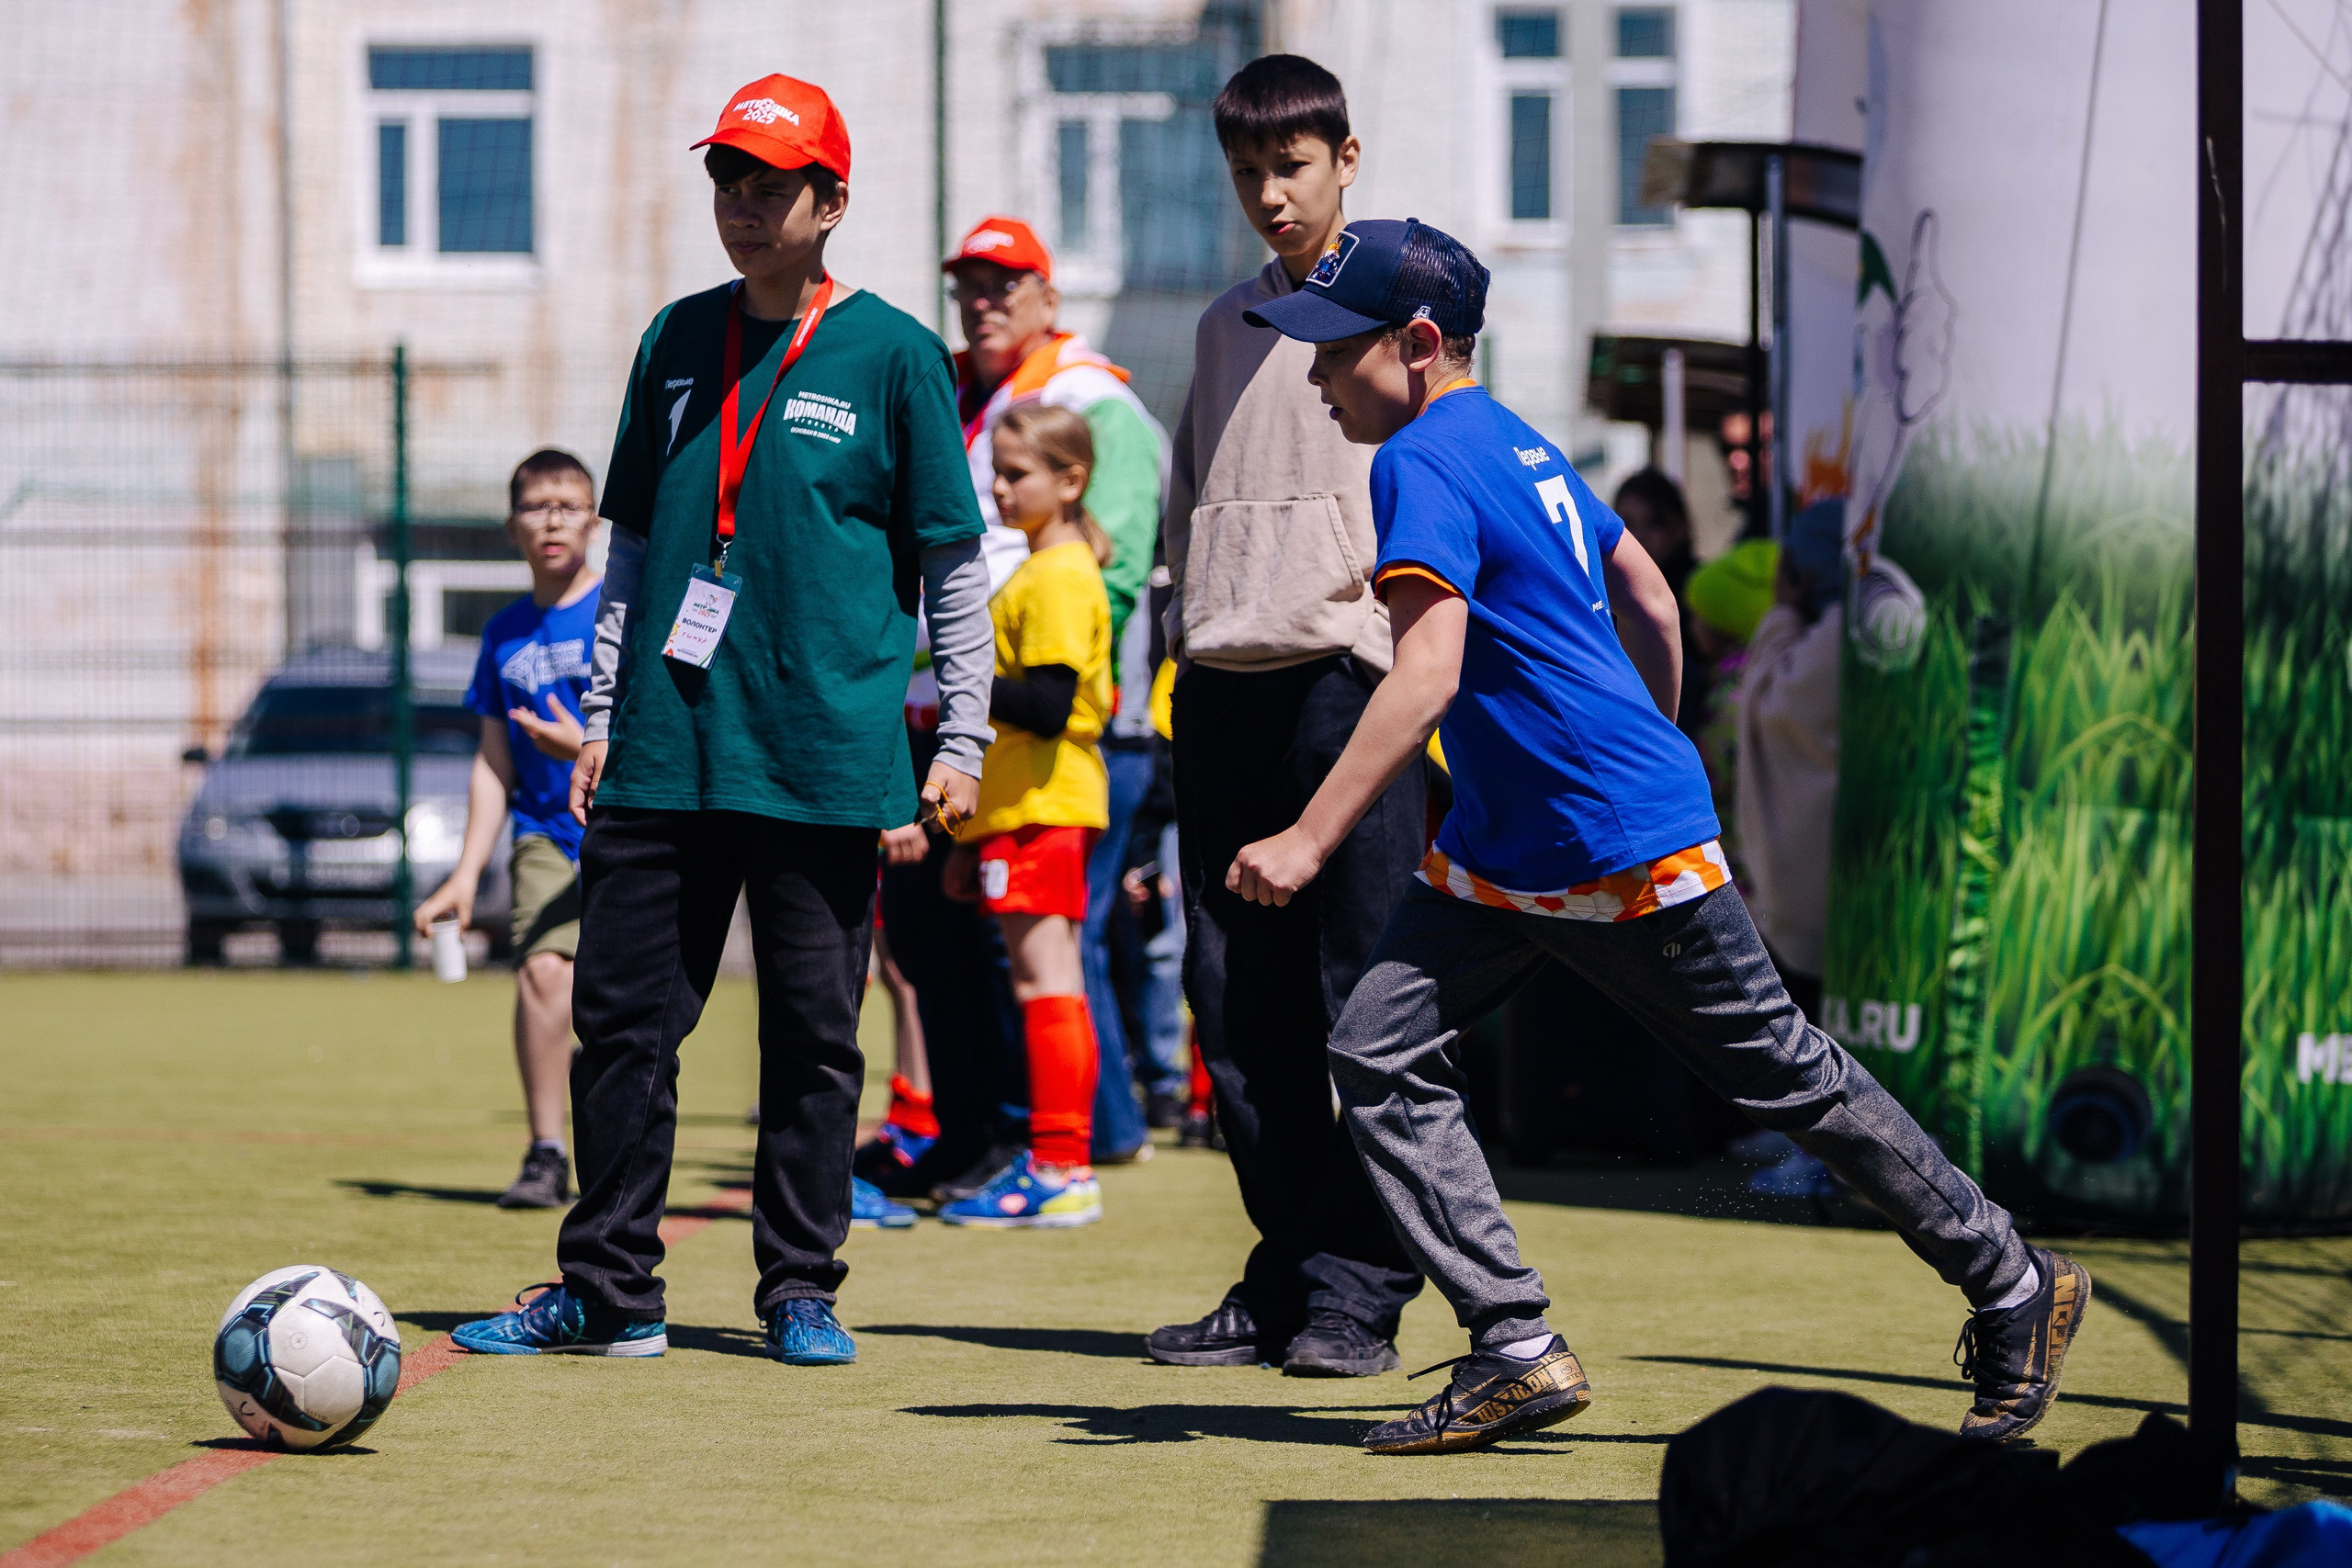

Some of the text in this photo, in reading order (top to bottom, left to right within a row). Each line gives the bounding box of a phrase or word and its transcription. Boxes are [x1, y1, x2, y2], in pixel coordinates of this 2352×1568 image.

[741, 108, 778, 124] 2025
[664, 377, 694, 390] Первые
[797, 390, 852, 410] METROSHKA.RU
[783, 398, 857, 436] КОМАНДА
[1512, 446, 1551, 471] Первые
[682, 617, 717, 633] ВОЛОНТЕР
